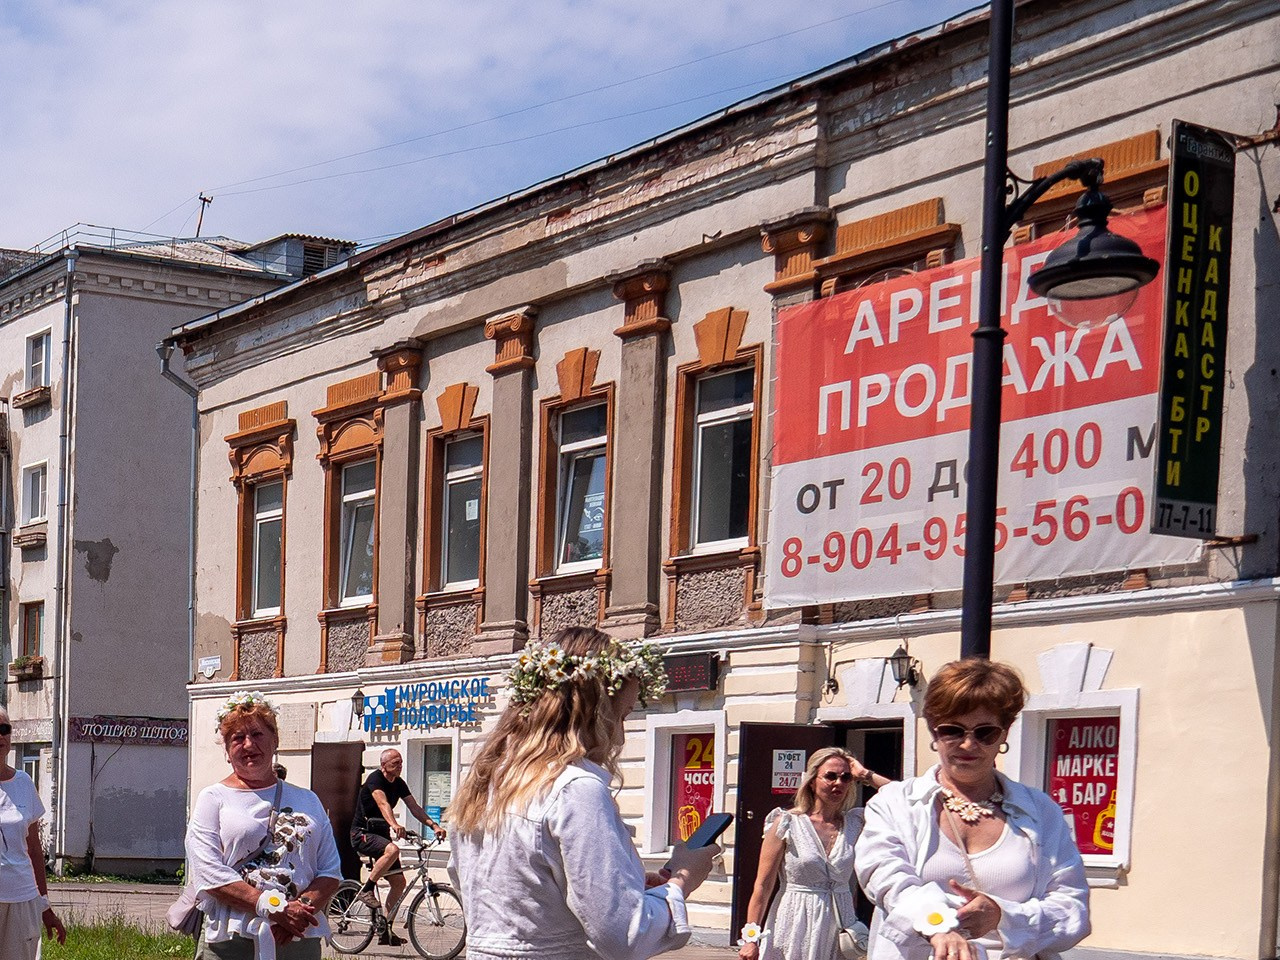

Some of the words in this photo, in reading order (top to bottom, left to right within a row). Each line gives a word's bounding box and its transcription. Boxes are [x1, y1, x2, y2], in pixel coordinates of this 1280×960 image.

[1174, 170, 1200, 358] ОЦЕНКА
[843, 250, 1062, 354] АРЕНД
[1195, 225, 1222, 442] КАДАСТР
[1166, 396, 1186, 486] БТИ
[796, 479, 845, 514] от
[859, 457, 912, 506] 20
[927, 458, 970, 502] д
[1010, 422, 1103, 478] 400
[1158, 503, 1213, 533] 77-7-11
[780, 486, 1145, 578] 8-904-955-56-0
[399, 677, 491, 702] МУРОМСКОЕ
[398, 703, 478, 728] ПОДВОРЬЕ
[81, 724, 137, 738] ПОШИВ
[1069, 725, 1117, 749] АЛКО
[685, 738, 714, 769] 24
[777, 752, 801, 762] БУФЕТ
[784, 761, 793, 769] 24
[1056, 753, 1118, 777] МАРКЕ
[779, 776, 798, 787] 24/7
[1072, 782, 1108, 806] БАР
